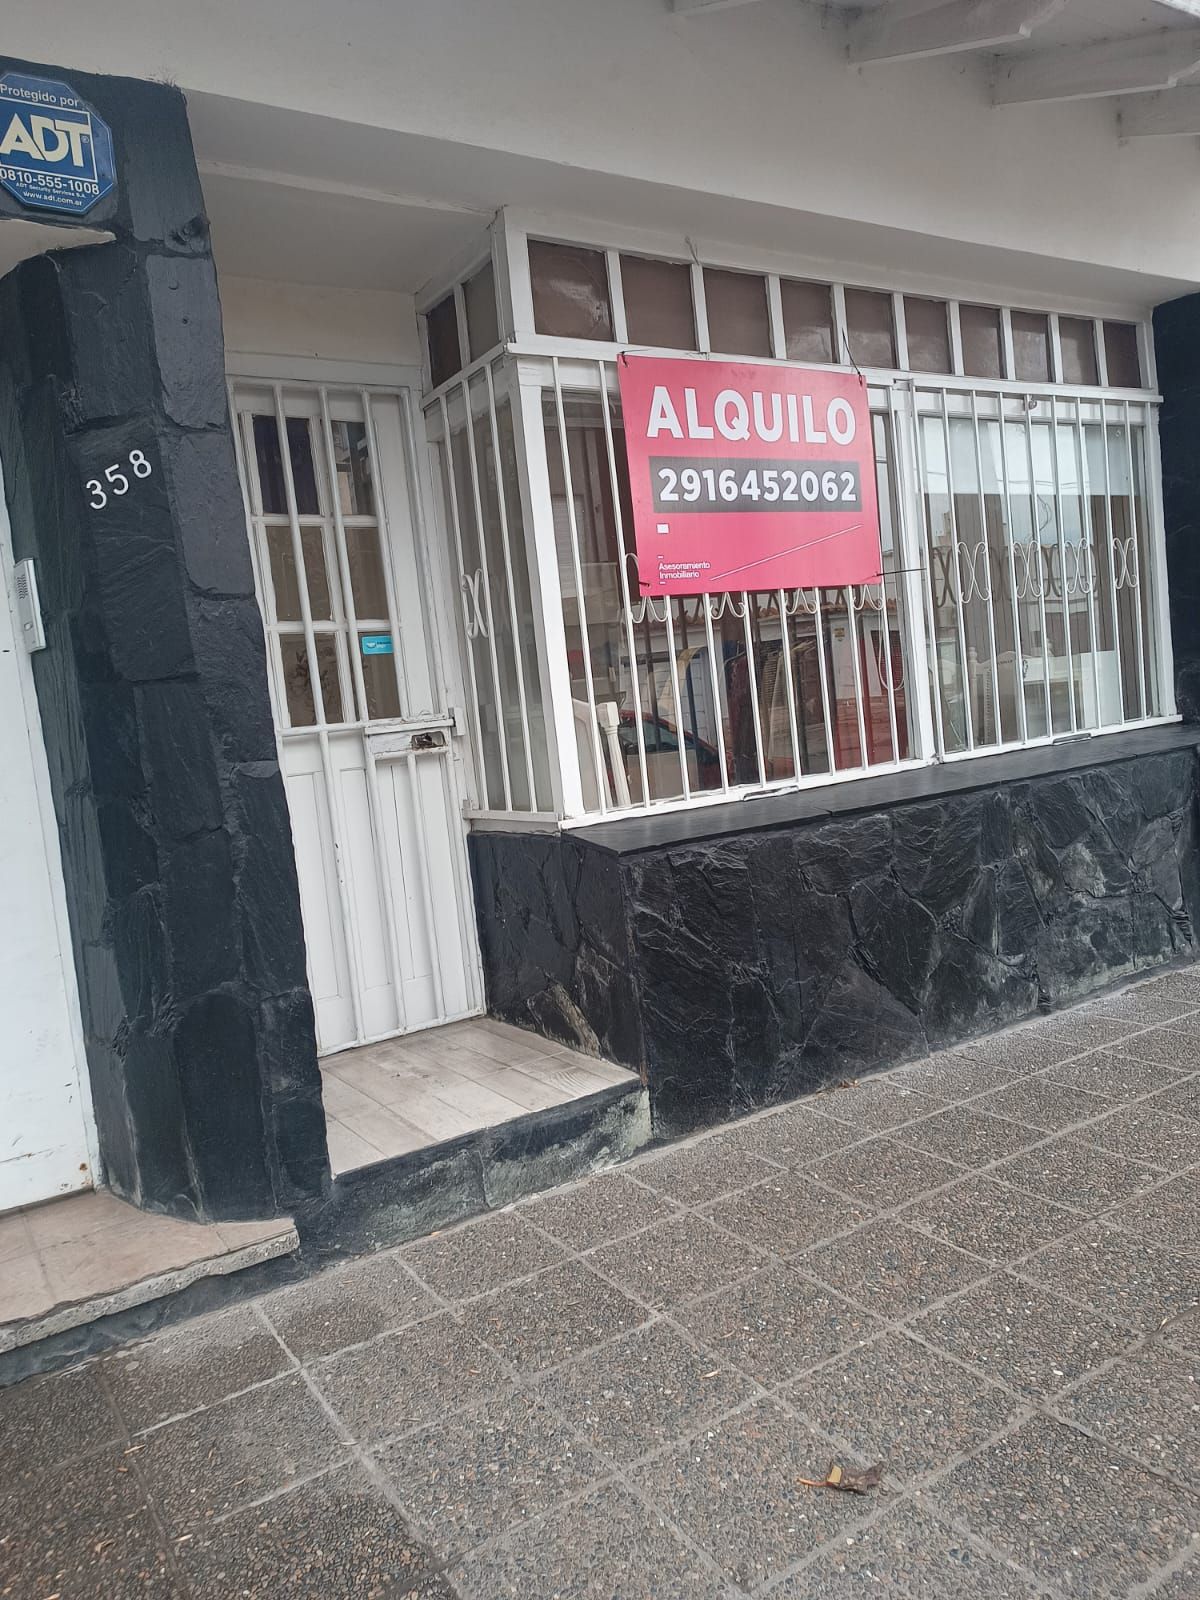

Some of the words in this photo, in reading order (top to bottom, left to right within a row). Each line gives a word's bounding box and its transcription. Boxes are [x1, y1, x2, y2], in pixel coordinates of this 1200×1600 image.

[0, 83, 56, 103] Protegido
[60, 96, 78, 107] por
[0, 112, 90, 167] ADT
[0, 168, 100, 195] 0810-555-1008
[23, 190, 82, 206] www.adt.com.ar
[646, 385, 856, 446] ALQUILO
[86, 449, 152, 510] 358
[657, 467, 857, 502] 2916452062
[658, 561, 711, 571] Asesoramiento
[659, 570, 700, 579] Inmobiliario
